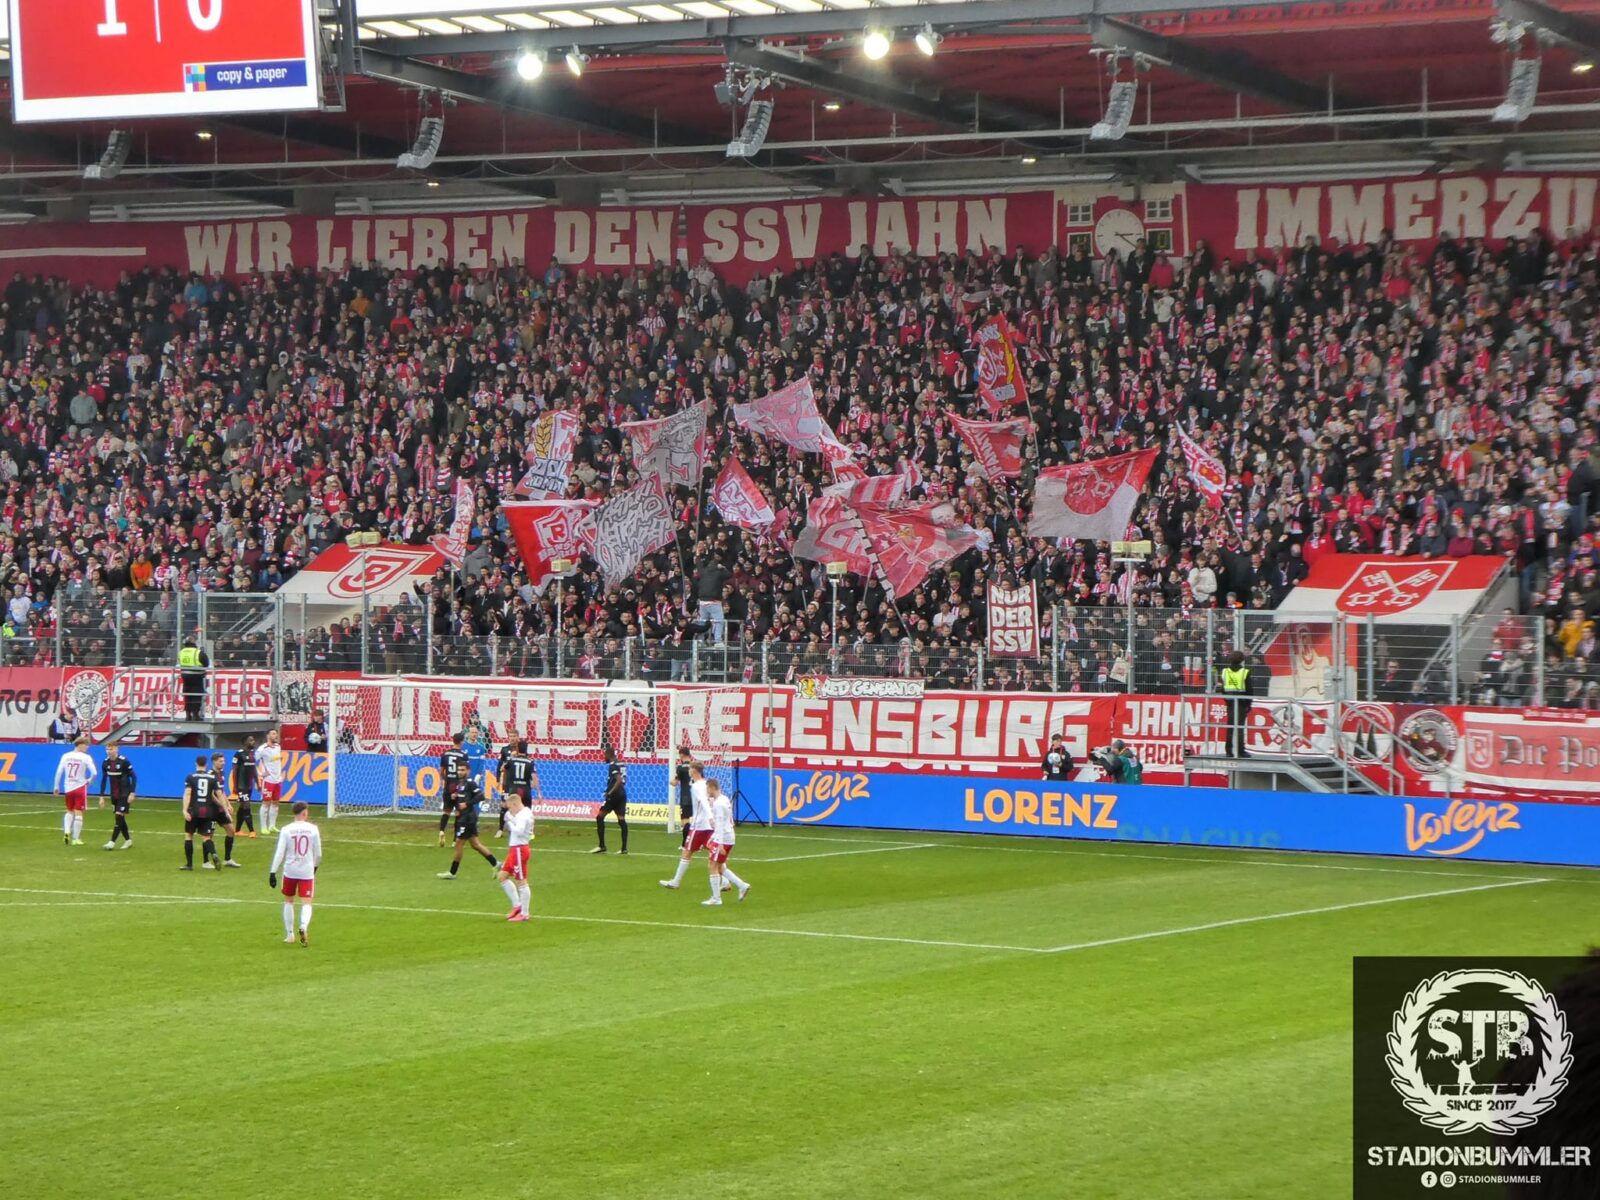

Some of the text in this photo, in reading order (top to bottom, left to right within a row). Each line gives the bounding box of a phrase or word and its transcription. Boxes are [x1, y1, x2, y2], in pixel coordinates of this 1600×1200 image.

[216, 66, 287, 84] copy & paper
[184, 176, 1598, 276] WIR LIEBEN DEN SSV JAHN IMMERZU
[991, 584, 1030, 605] NUR
[991, 605, 1033, 627] DER
[992, 628, 1033, 652] SSV
[822, 679, 924, 697] RED GENERATION
[380, 686, 1091, 758] ULTRAS REGENSBURG
[1122, 701, 1203, 737] JAHN
[67, 762, 80, 779] 27
[448, 756, 457, 773] 5
[514, 762, 526, 779] 11
[197, 778, 208, 797] 9
[775, 771, 870, 820] Lorenz
[965, 788, 1118, 828] LORENZ
[1404, 800, 1521, 851] Lorenz
[291, 835, 309, 857] 10
